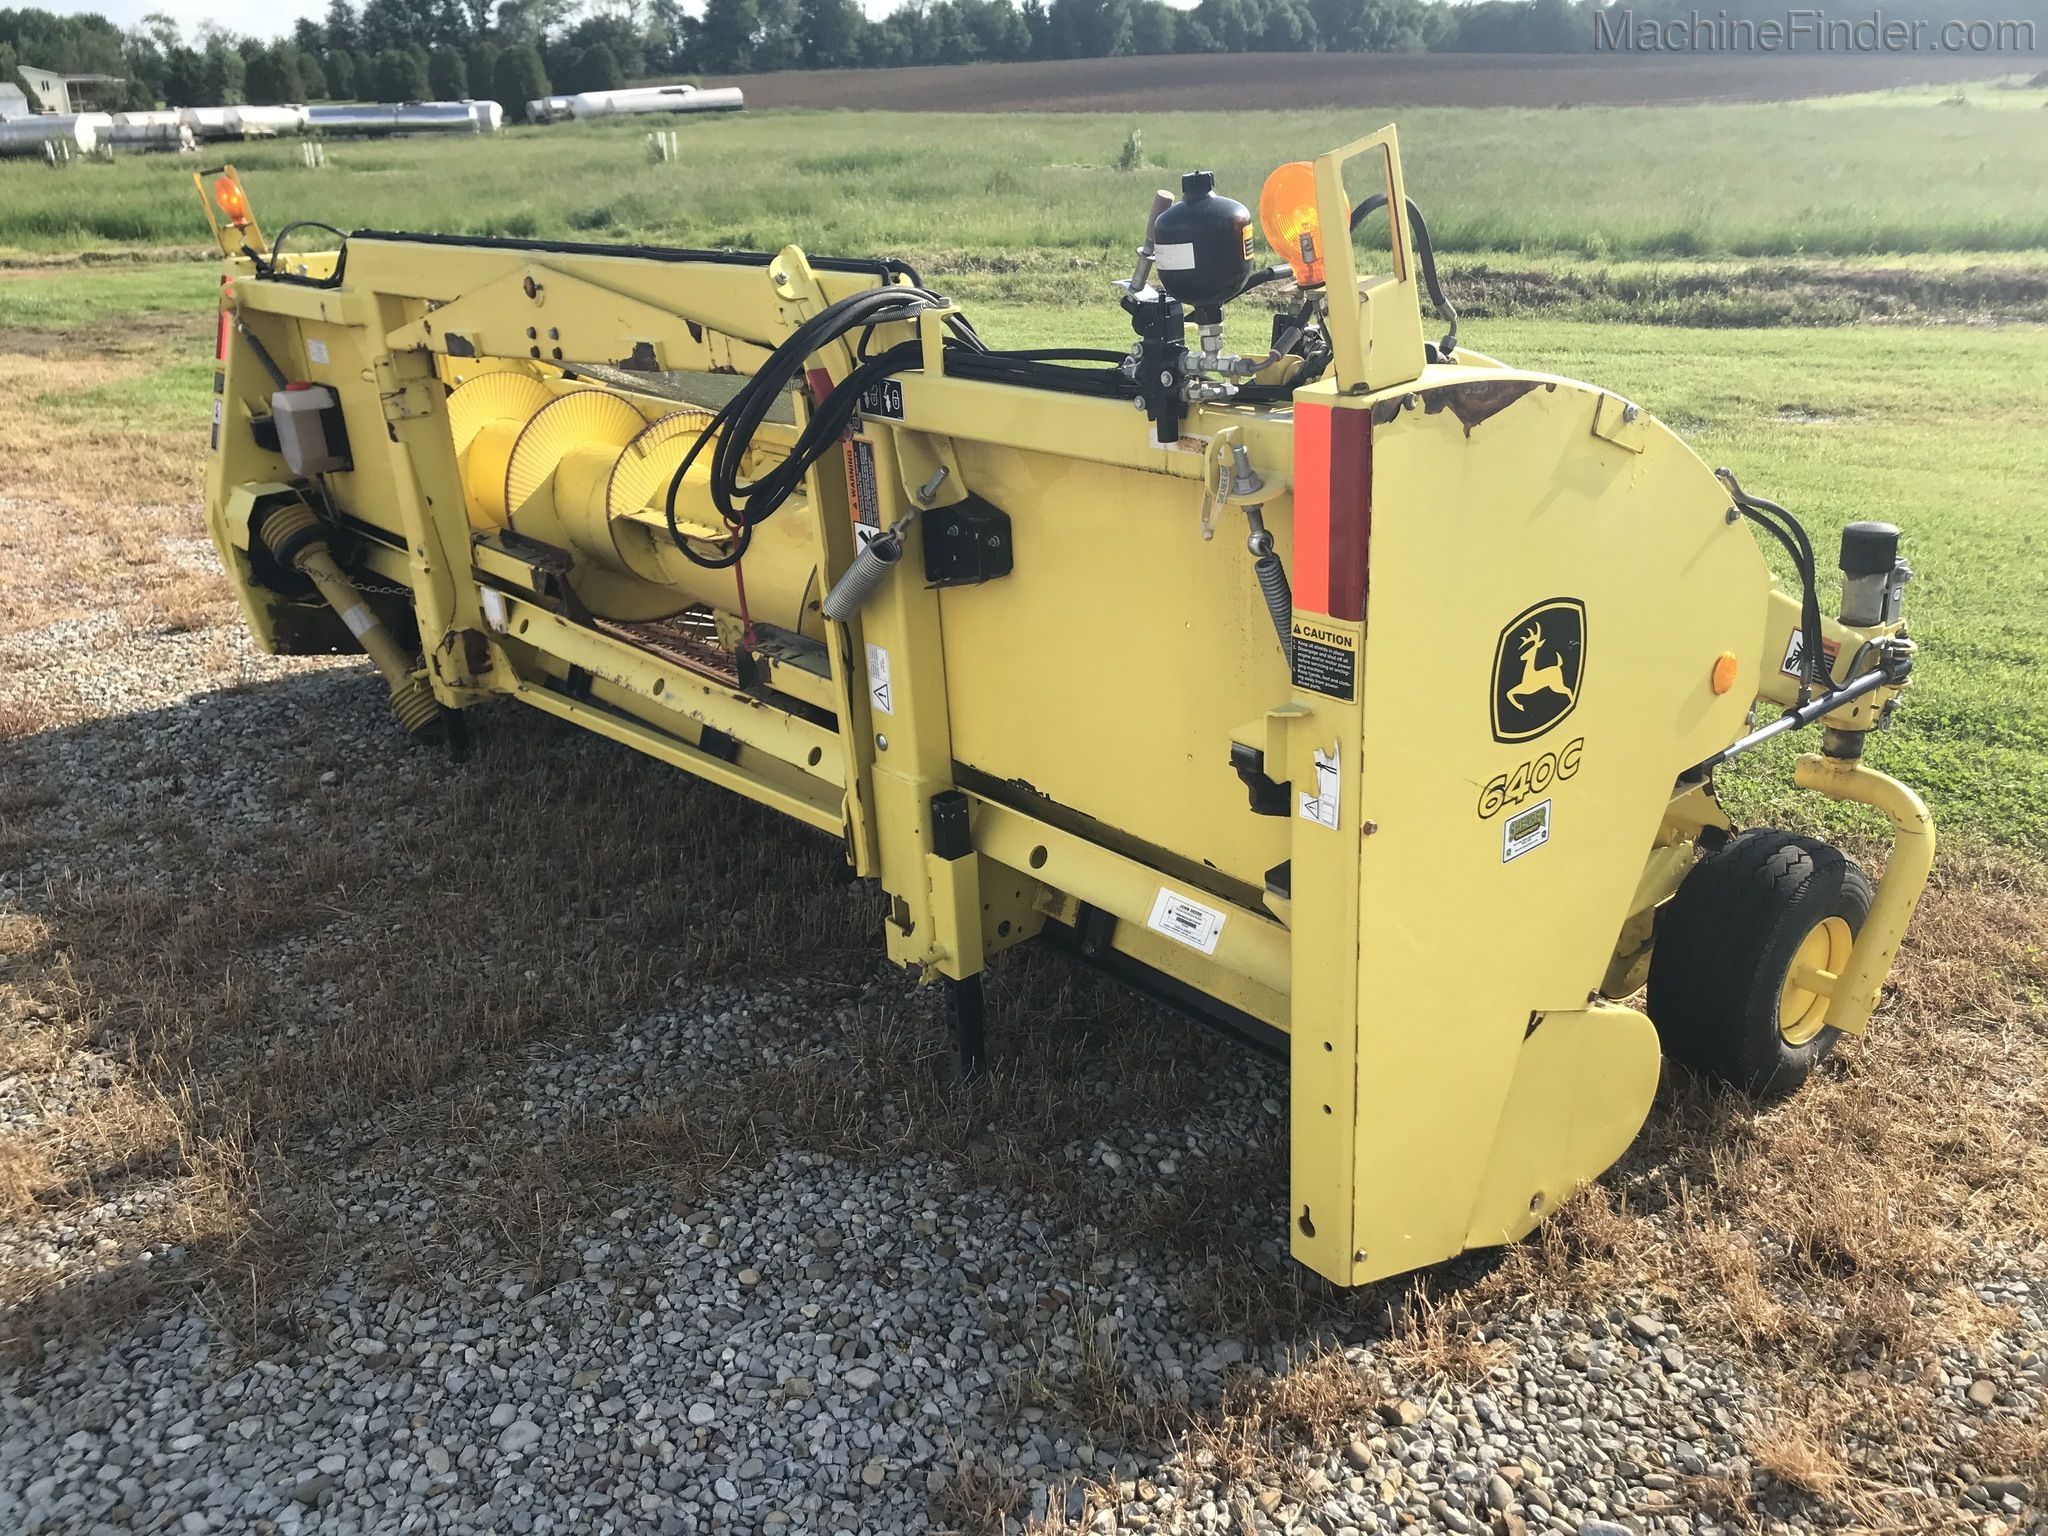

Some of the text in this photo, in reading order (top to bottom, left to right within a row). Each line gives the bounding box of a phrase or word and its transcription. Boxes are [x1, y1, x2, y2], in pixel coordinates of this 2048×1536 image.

[847, 450, 856, 497] WARNING
[1303, 626, 1352, 647] CAUTION
[1477, 736, 1585, 820] 640C
